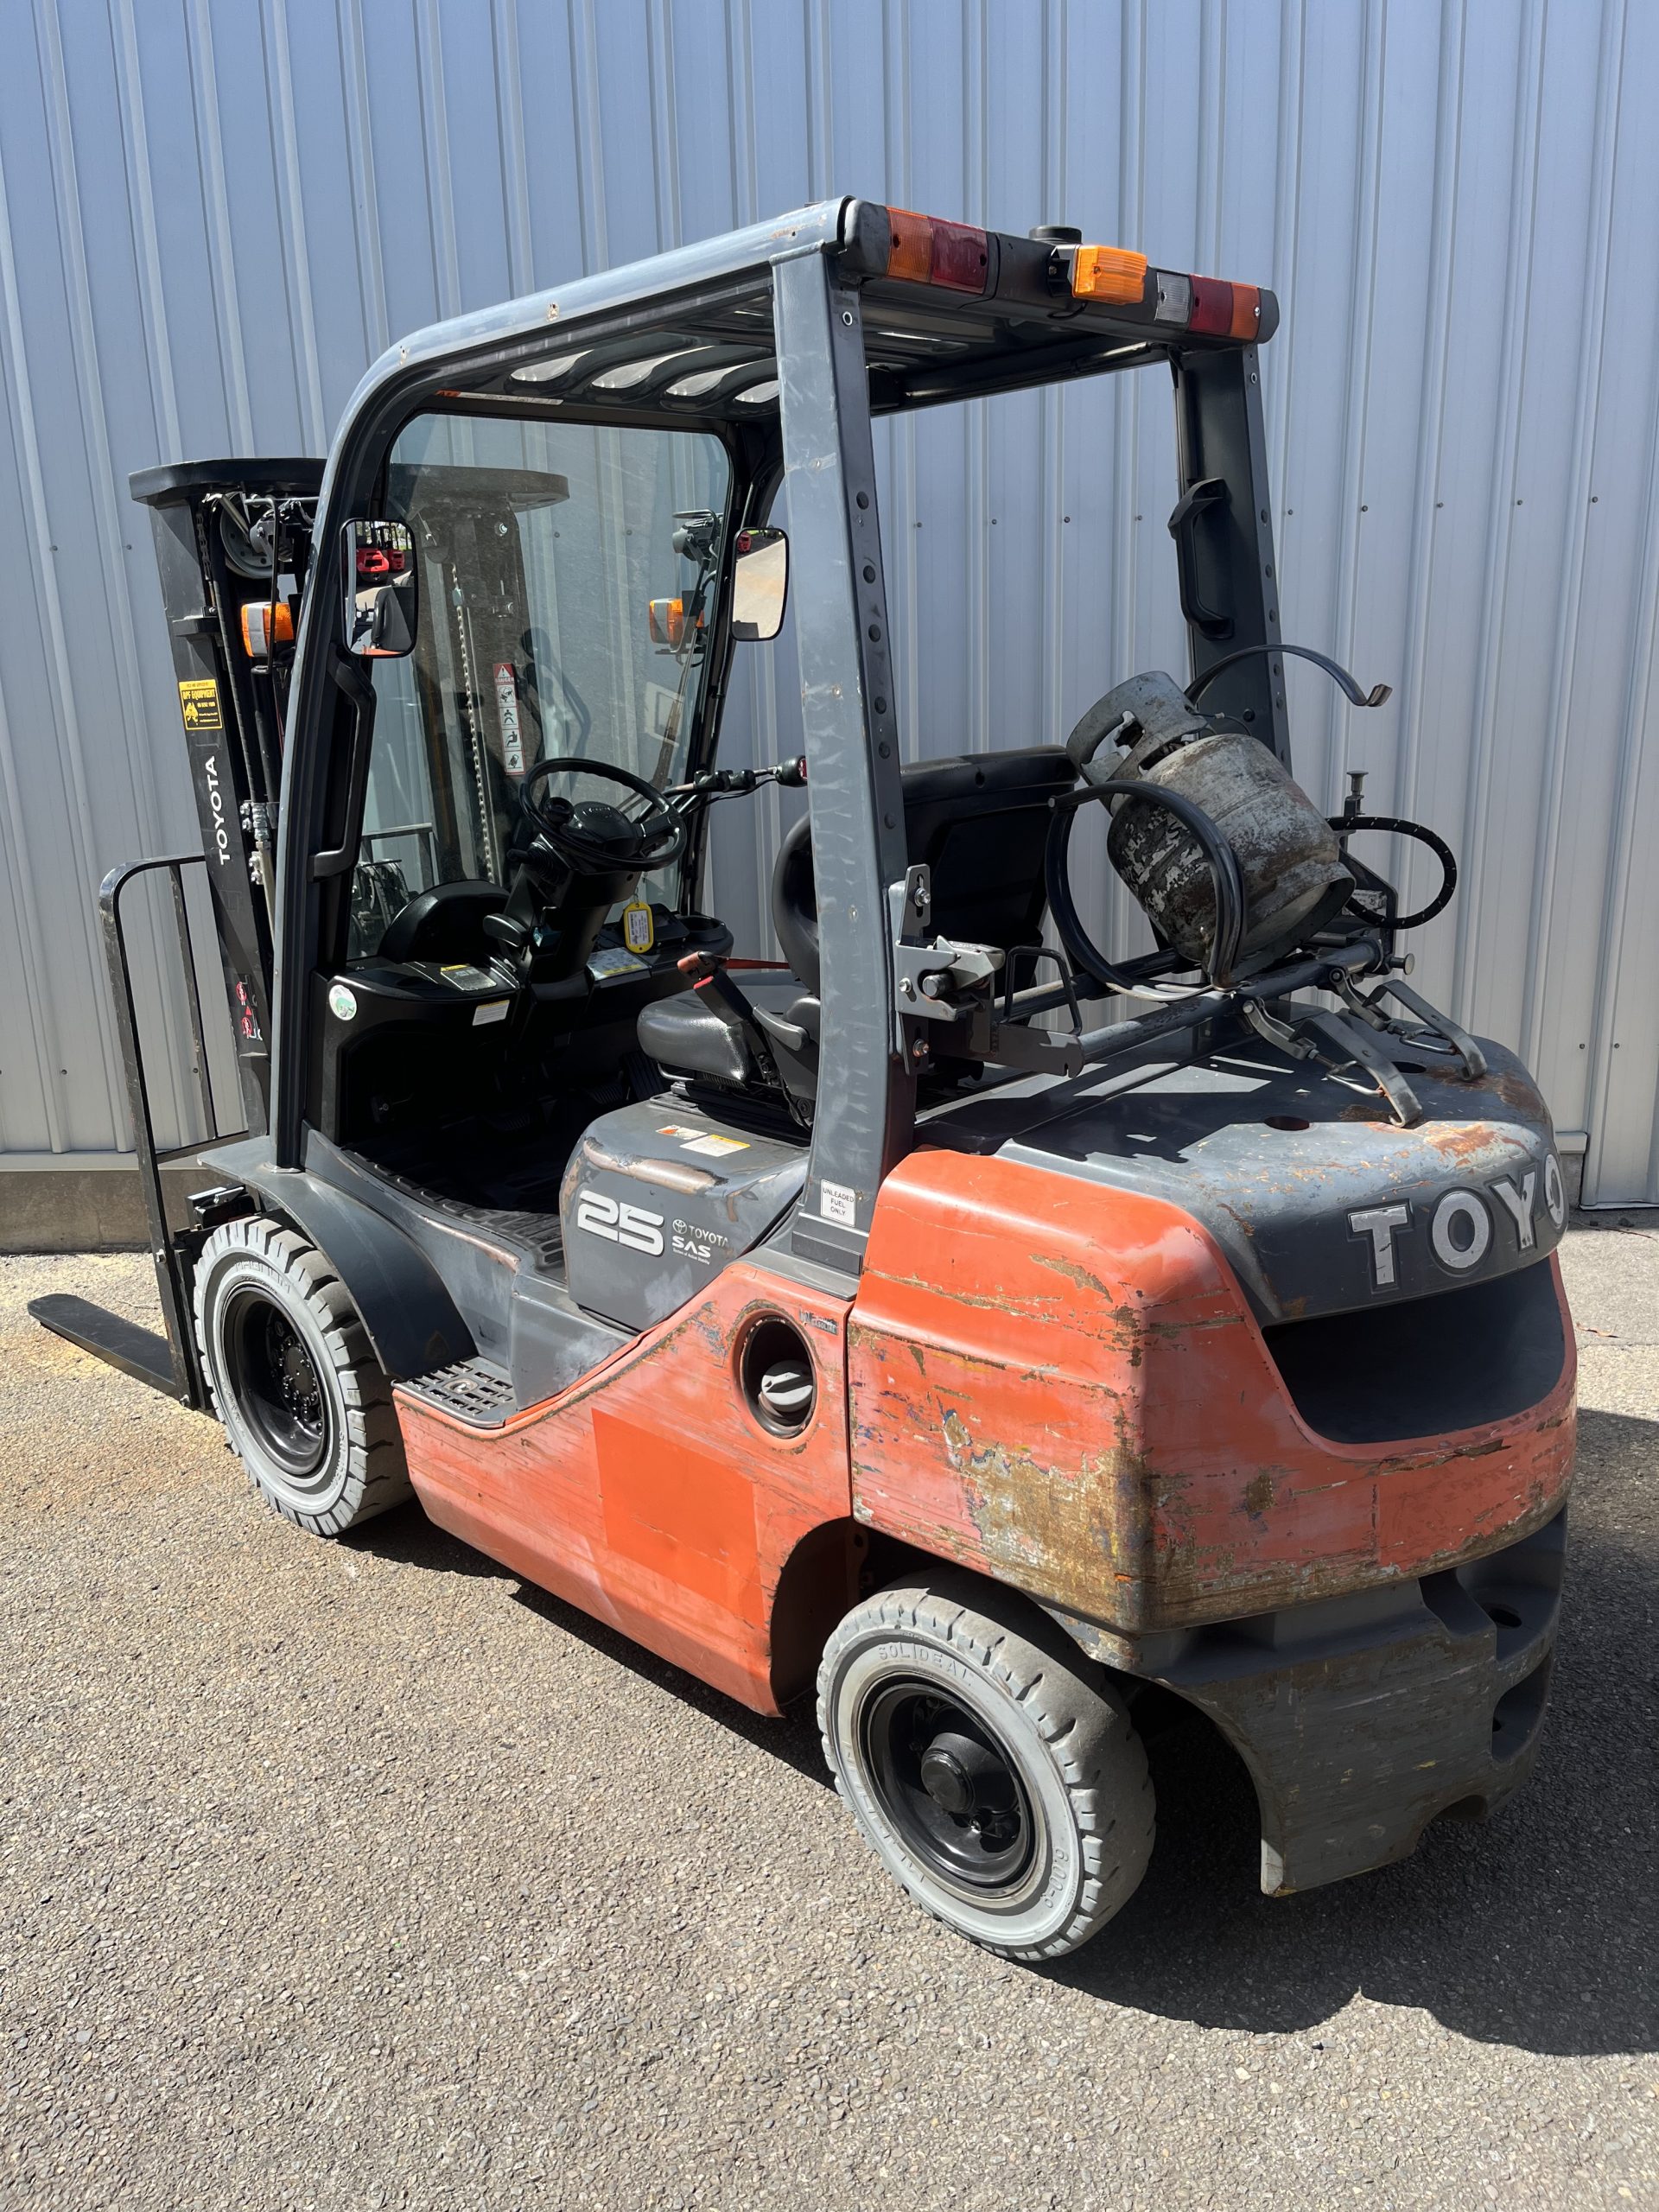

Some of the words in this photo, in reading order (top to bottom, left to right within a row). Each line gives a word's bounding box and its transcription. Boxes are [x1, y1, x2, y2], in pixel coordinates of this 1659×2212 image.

[191, 689, 215, 700] EQUIPMENT
[206, 756, 230, 865] TOYOTA
[823, 1188, 855, 1203] UNLEADED
[830, 1198, 846, 1208] FUEL
[830, 1206, 846, 1216] ONLY
[577, 1190, 664, 1255] 25
[671, 1235, 711, 1258] SAS
[879, 1641, 974, 1686] SOLIDEAL
